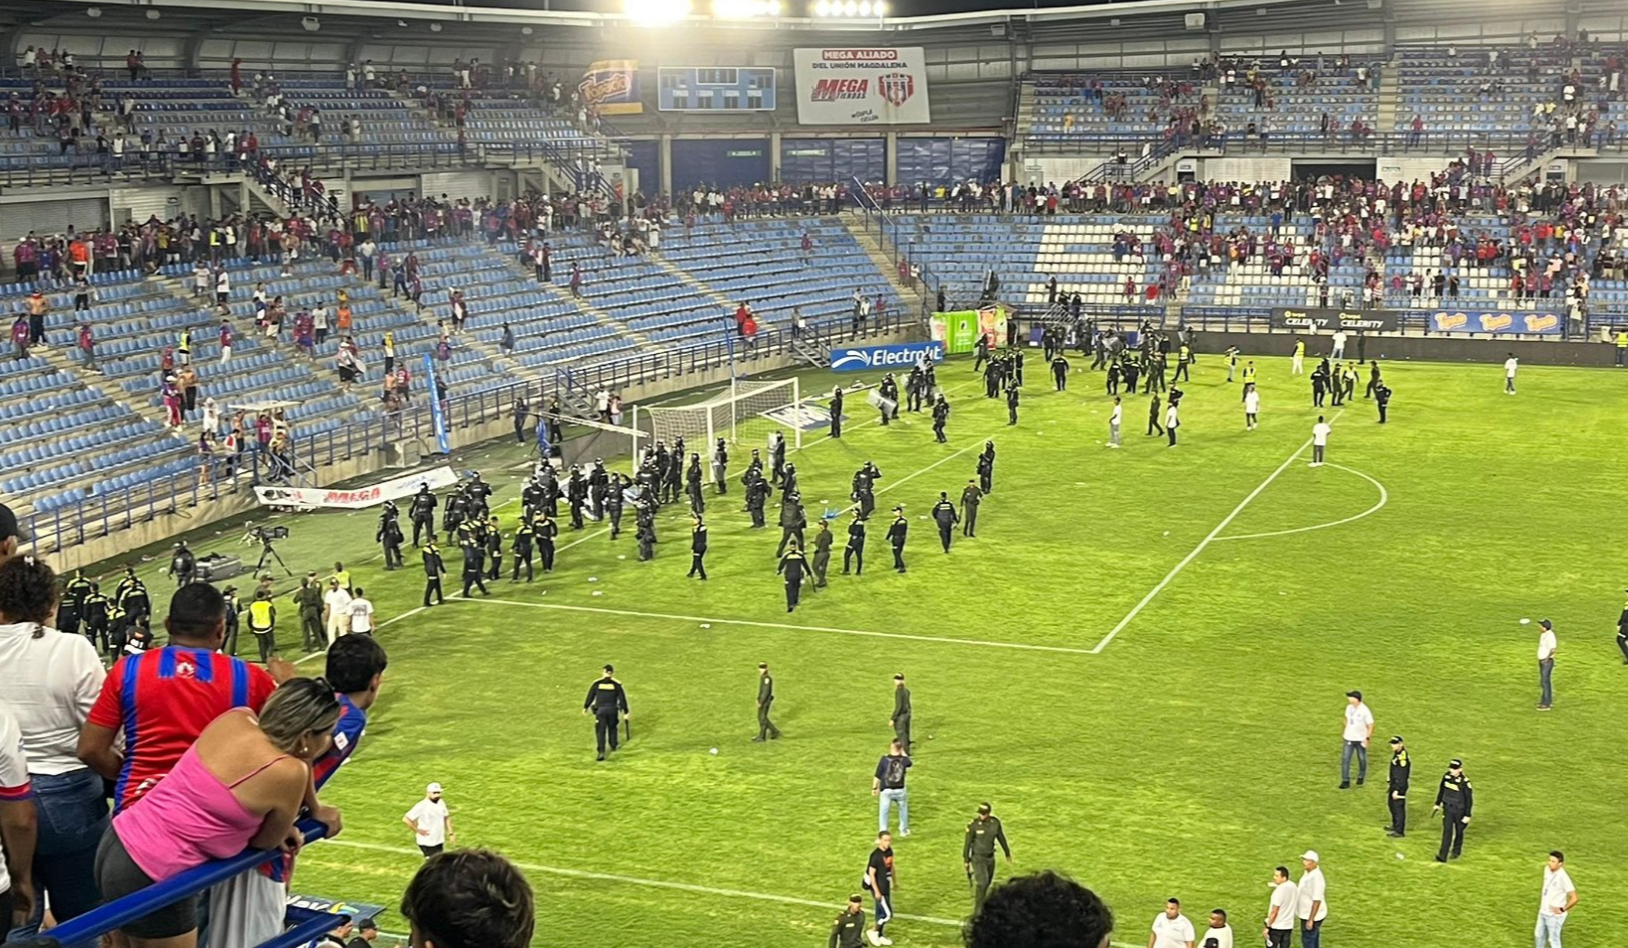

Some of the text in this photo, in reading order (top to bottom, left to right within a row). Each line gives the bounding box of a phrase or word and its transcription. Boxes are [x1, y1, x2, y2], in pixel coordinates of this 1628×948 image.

[824, 51, 896, 59] MEGA ALIADO
[816, 79, 868, 96] MEGA
[1285, 318, 1329, 327] CELERTY
[1340, 320, 1384, 328] CELERITY
